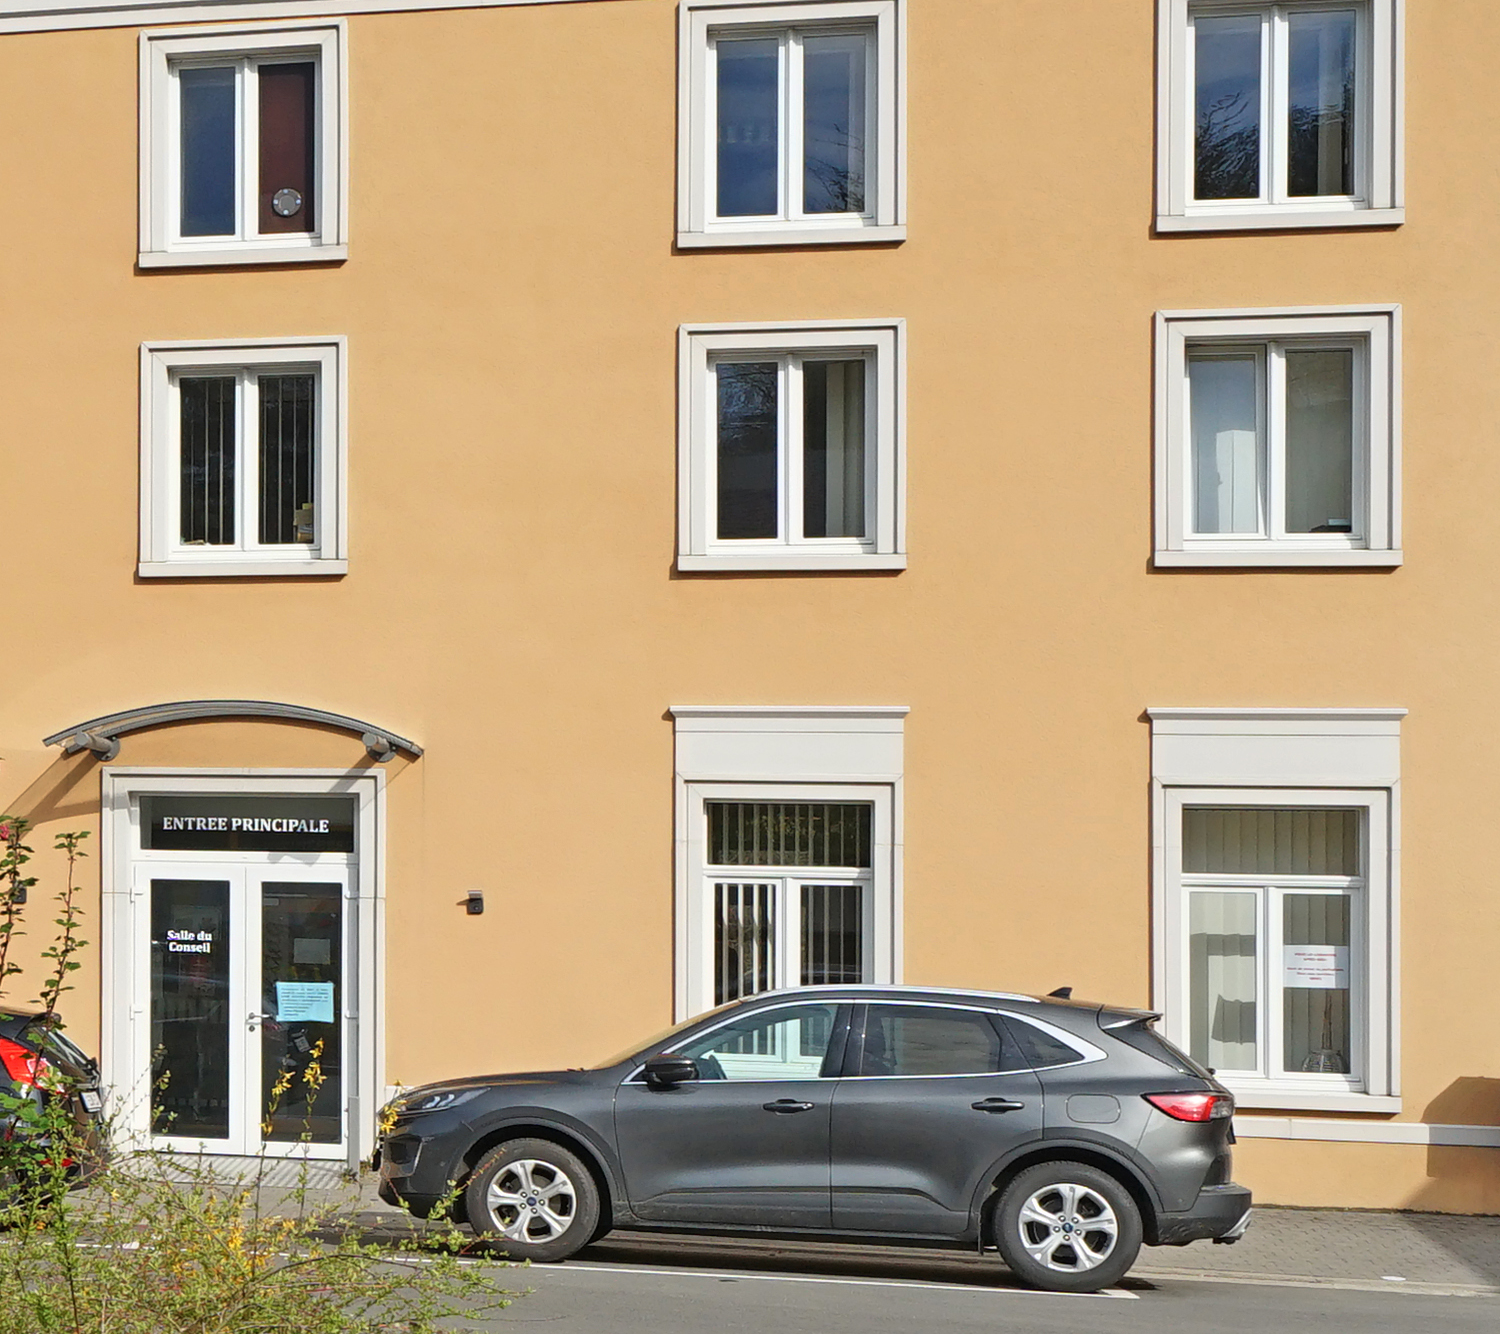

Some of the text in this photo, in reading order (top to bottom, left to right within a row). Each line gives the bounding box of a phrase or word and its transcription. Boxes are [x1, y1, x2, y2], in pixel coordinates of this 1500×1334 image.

[163, 816, 329, 833] ENTREE PRINCIPALE
[167, 930, 212, 941] Salle du
[168, 942, 211, 953] Conseil
